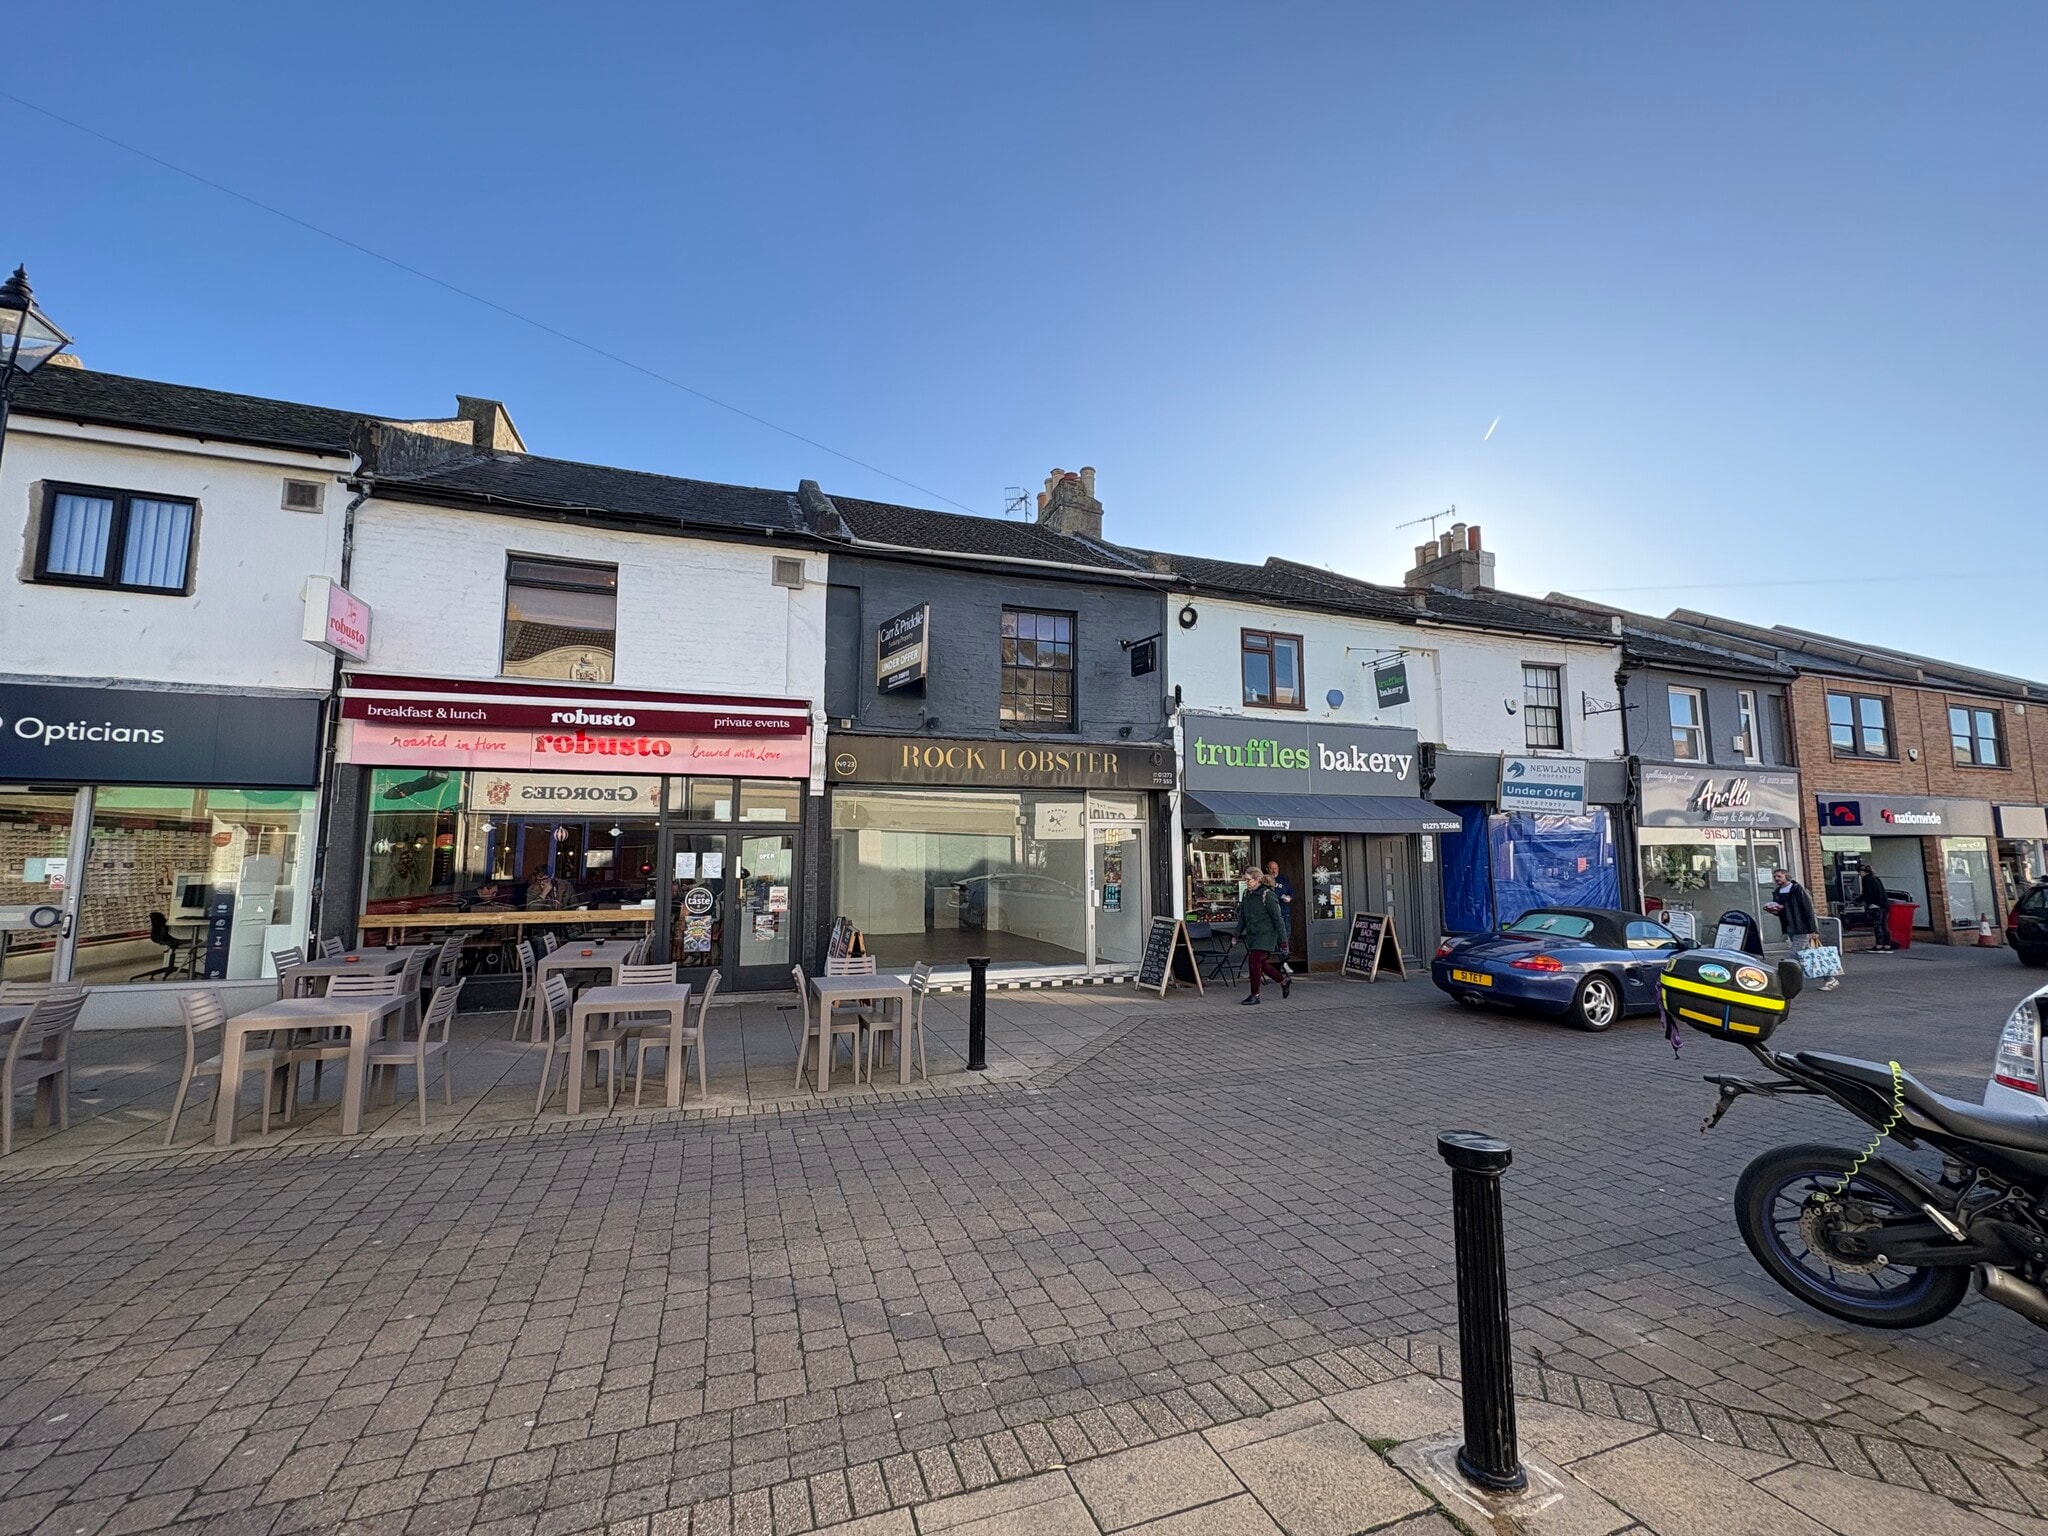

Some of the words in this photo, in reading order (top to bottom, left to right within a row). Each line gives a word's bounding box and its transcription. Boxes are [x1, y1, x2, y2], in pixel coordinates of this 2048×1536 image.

[330, 617, 365, 644] robusto
[881, 627, 895, 642] Carr
[900, 611, 923, 634] Priddle
[882, 657, 900, 672] UNDER
[901, 649, 918, 665] OFFER
[1377, 676, 1404, 688] truffles
[1379, 685, 1404, 697] bakery
[367, 704, 433, 719] breakfast
[436, 707, 447, 718] &
[450, 707, 487, 720] lunch
[551, 709, 636, 727] robusto
[714, 716, 752, 729] private
[755, 718, 790, 728] events
[14, 717, 164, 746] Opticians
[390, 734, 448, 748] roasted
[455, 739, 470, 751] in
[474, 736, 507, 751] Hove
[534, 728, 672, 758] robusto
[733, 747, 755, 759] with
[756, 746, 781, 761] Love
[902, 745, 986, 770] ROCK
[1000, 746, 1118, 774] LOBSTER
[1194, 736, 1310, 769] truffles
[1318, 743, 1412, 781] bakery
[1530, 764, 1581, 774] NEWLANDS
[1506, 785, 1542, 796] Under
[1544, 788, 1577, 799] Offer
[1697, 777, 1751, 811] Apollo
[1257, 817, 1290, 830] bakery
[1894, 810, 1941, 825] nationwide
[1422, 822, 1439, 830] 01273
[688, 897, 711, 905] taste
[1355, 921, 1369, 930] GUESS
[1469, 973, 1483, 983] TET
